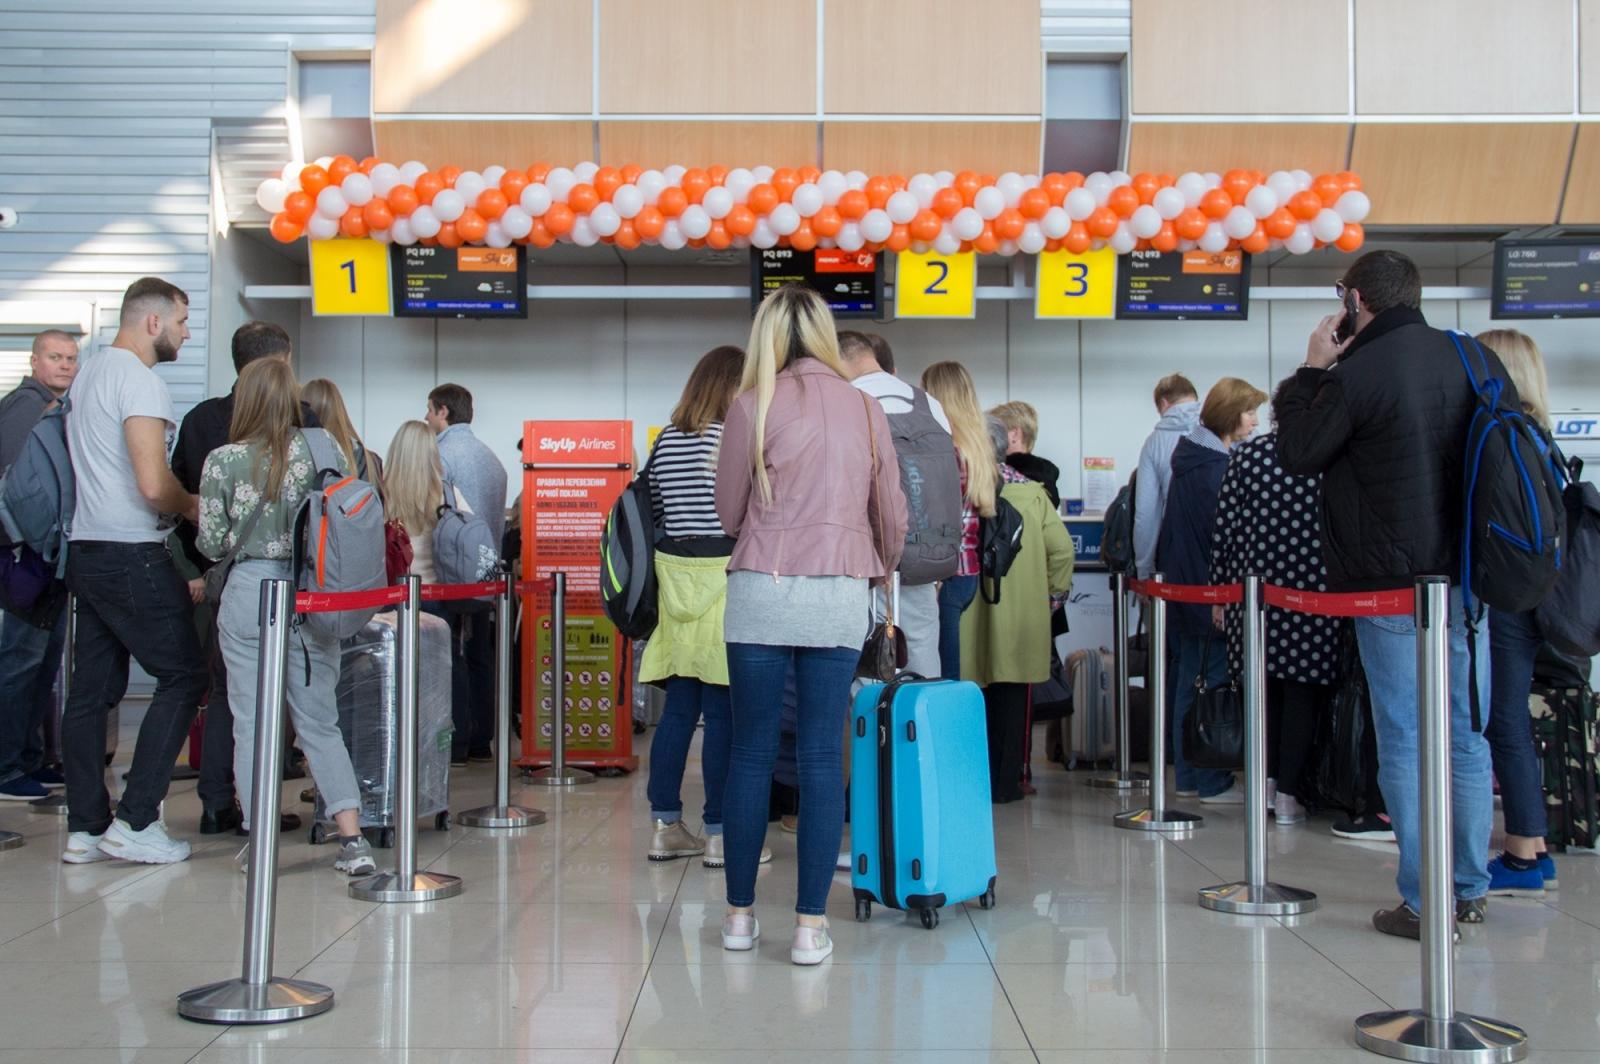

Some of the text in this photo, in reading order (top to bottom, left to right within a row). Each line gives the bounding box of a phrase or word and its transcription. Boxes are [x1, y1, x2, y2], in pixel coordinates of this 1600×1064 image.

[406, 248, 418, 256] PQ
[763, 250, 775, 259] PQ
[340, 260, 356, 293] 1
[924, 261, 948, 294] 2
[1064, 263, 1088, 296] 3
[1556, 420, 1596, 434] LOT
[540, 437, 616, 452] SkyUp Airlines
